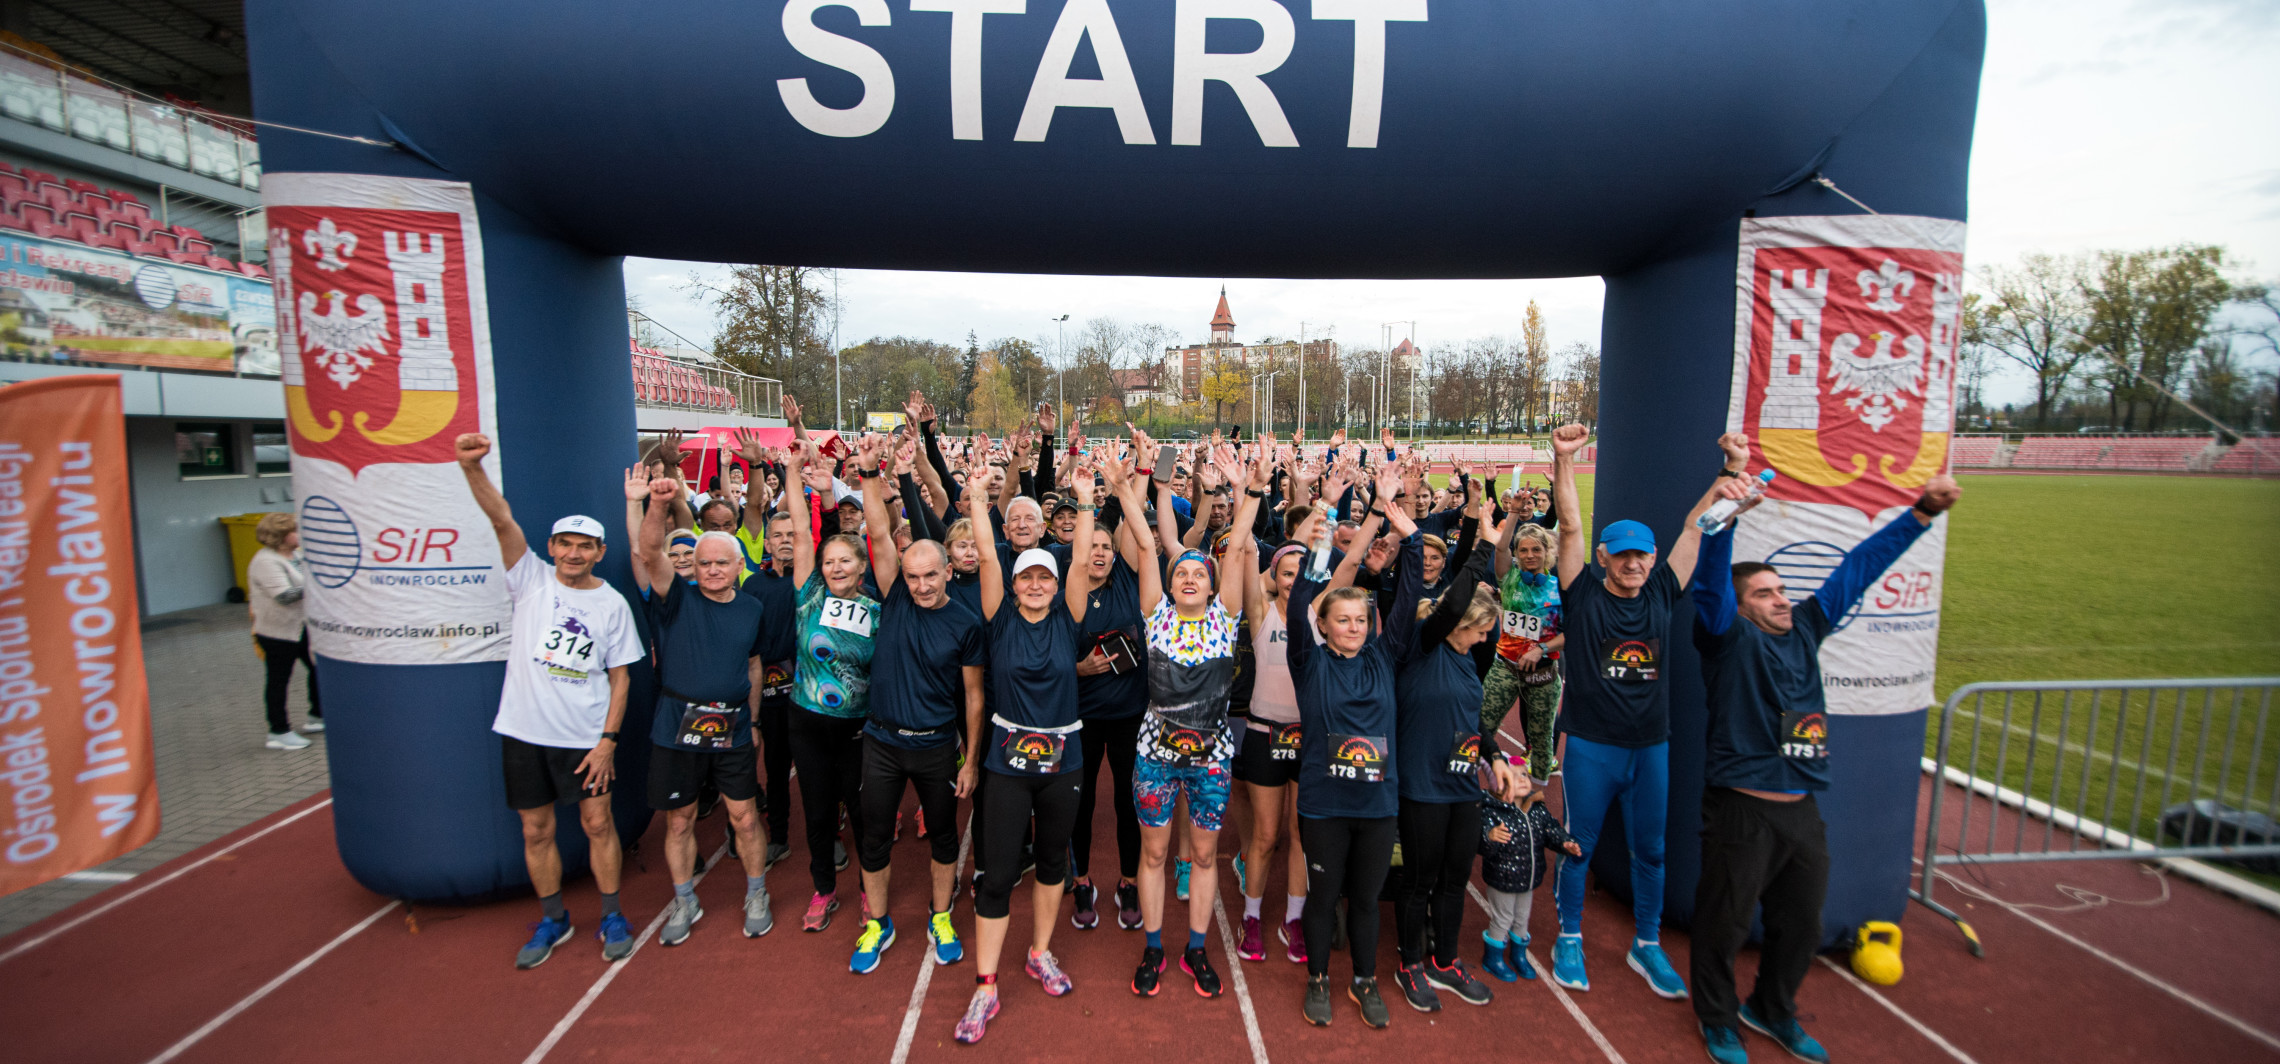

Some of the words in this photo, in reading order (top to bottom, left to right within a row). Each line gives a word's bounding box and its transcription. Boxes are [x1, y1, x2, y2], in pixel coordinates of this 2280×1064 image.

[776, 0, 1429, 148] START
[26, 245, 133, 285] Rekreacji
[177, 283, 213, 304] SiR
[373, 527, 460, 563] SiR
[370, 573, 487, 586] INOWROCŁAW
[1875, 571, 1933, 609] SiR
[47, 440, 131, 784] Inowrocławiu
[829, 600, 869, 624] 317
[1507, 612, 1538, 631] 313
[545, 630, 594, 661] 314
[1607, 666, 1627, 678] 17
[682, 733, 702, 745] 68
[1156, 745, 1181, 763] 267
[1272, 748, 1297, 760] 278
[1782, 743, 1815, 757] 175
[1008, 755, 1028, 770] 42
[1329, 763, 1357, 779] 178
[1449, 759, 1471, 773] 177
[1, 727, 59, 864] Ośrodek
[93, 793, 138, 837] w
